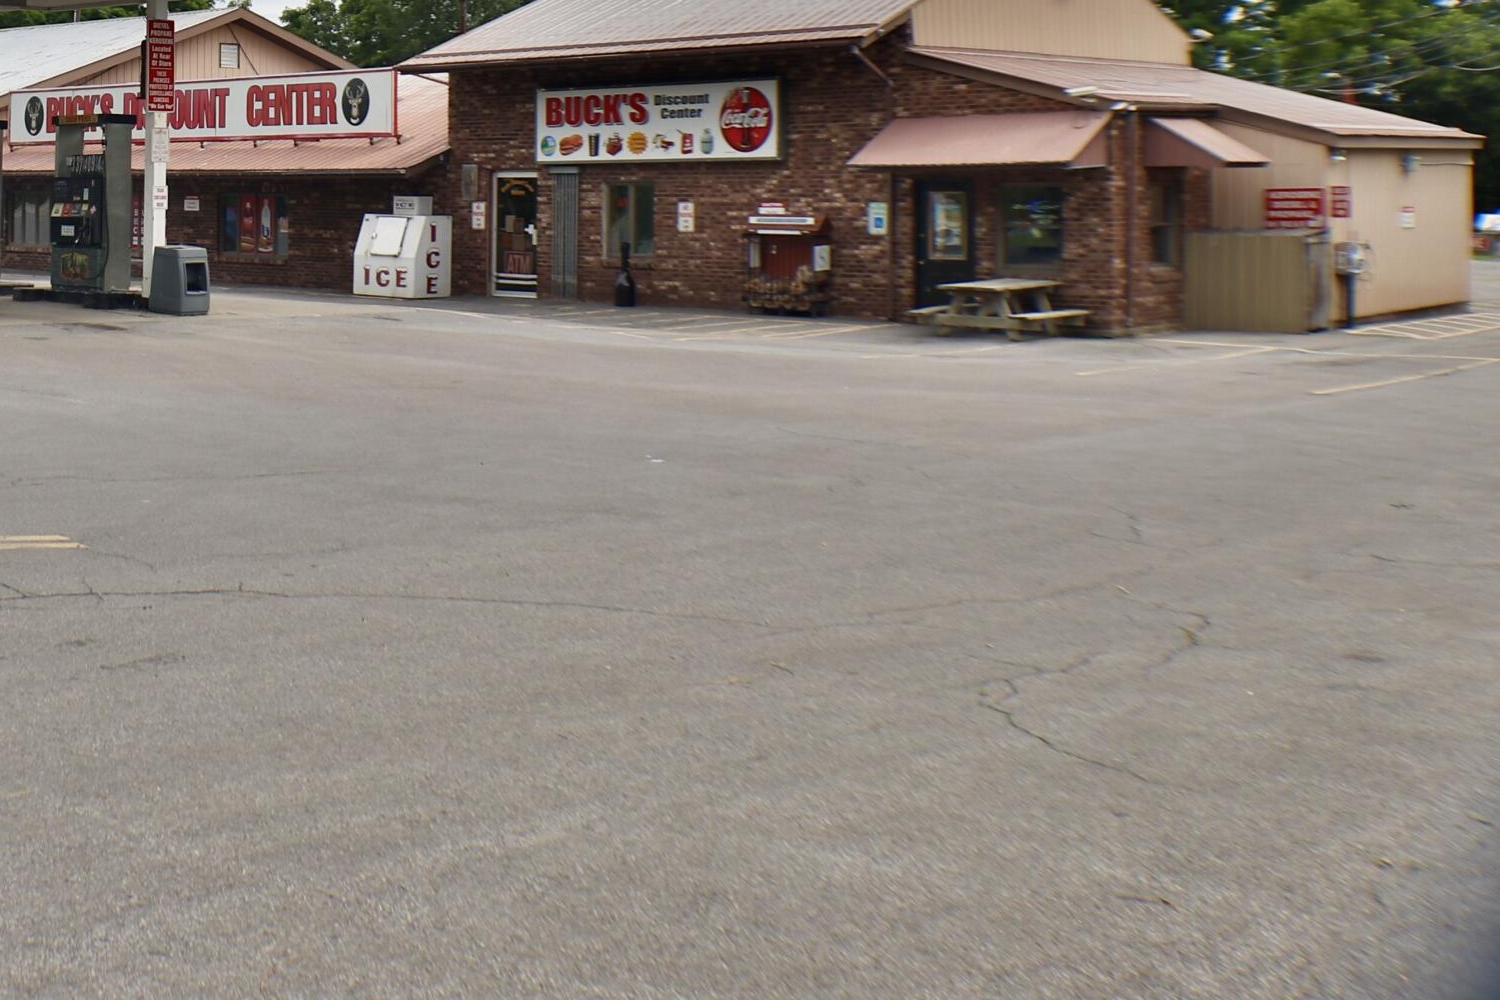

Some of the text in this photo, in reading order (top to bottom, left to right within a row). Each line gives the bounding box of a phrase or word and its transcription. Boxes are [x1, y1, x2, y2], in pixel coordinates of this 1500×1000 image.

[149, 37, 174, 45] KEROSENE
[150, 29, 172, 37] PROPANE
[246, 81, 338, 127] CENTER
[653, 93, 710, 107] Discount
[545, 92, 650, 128] BUCK'S
[660, 106, 703, 121] Center
[506, 254, 533, 275] ATM
[362, 265, 409, 289] ICE
